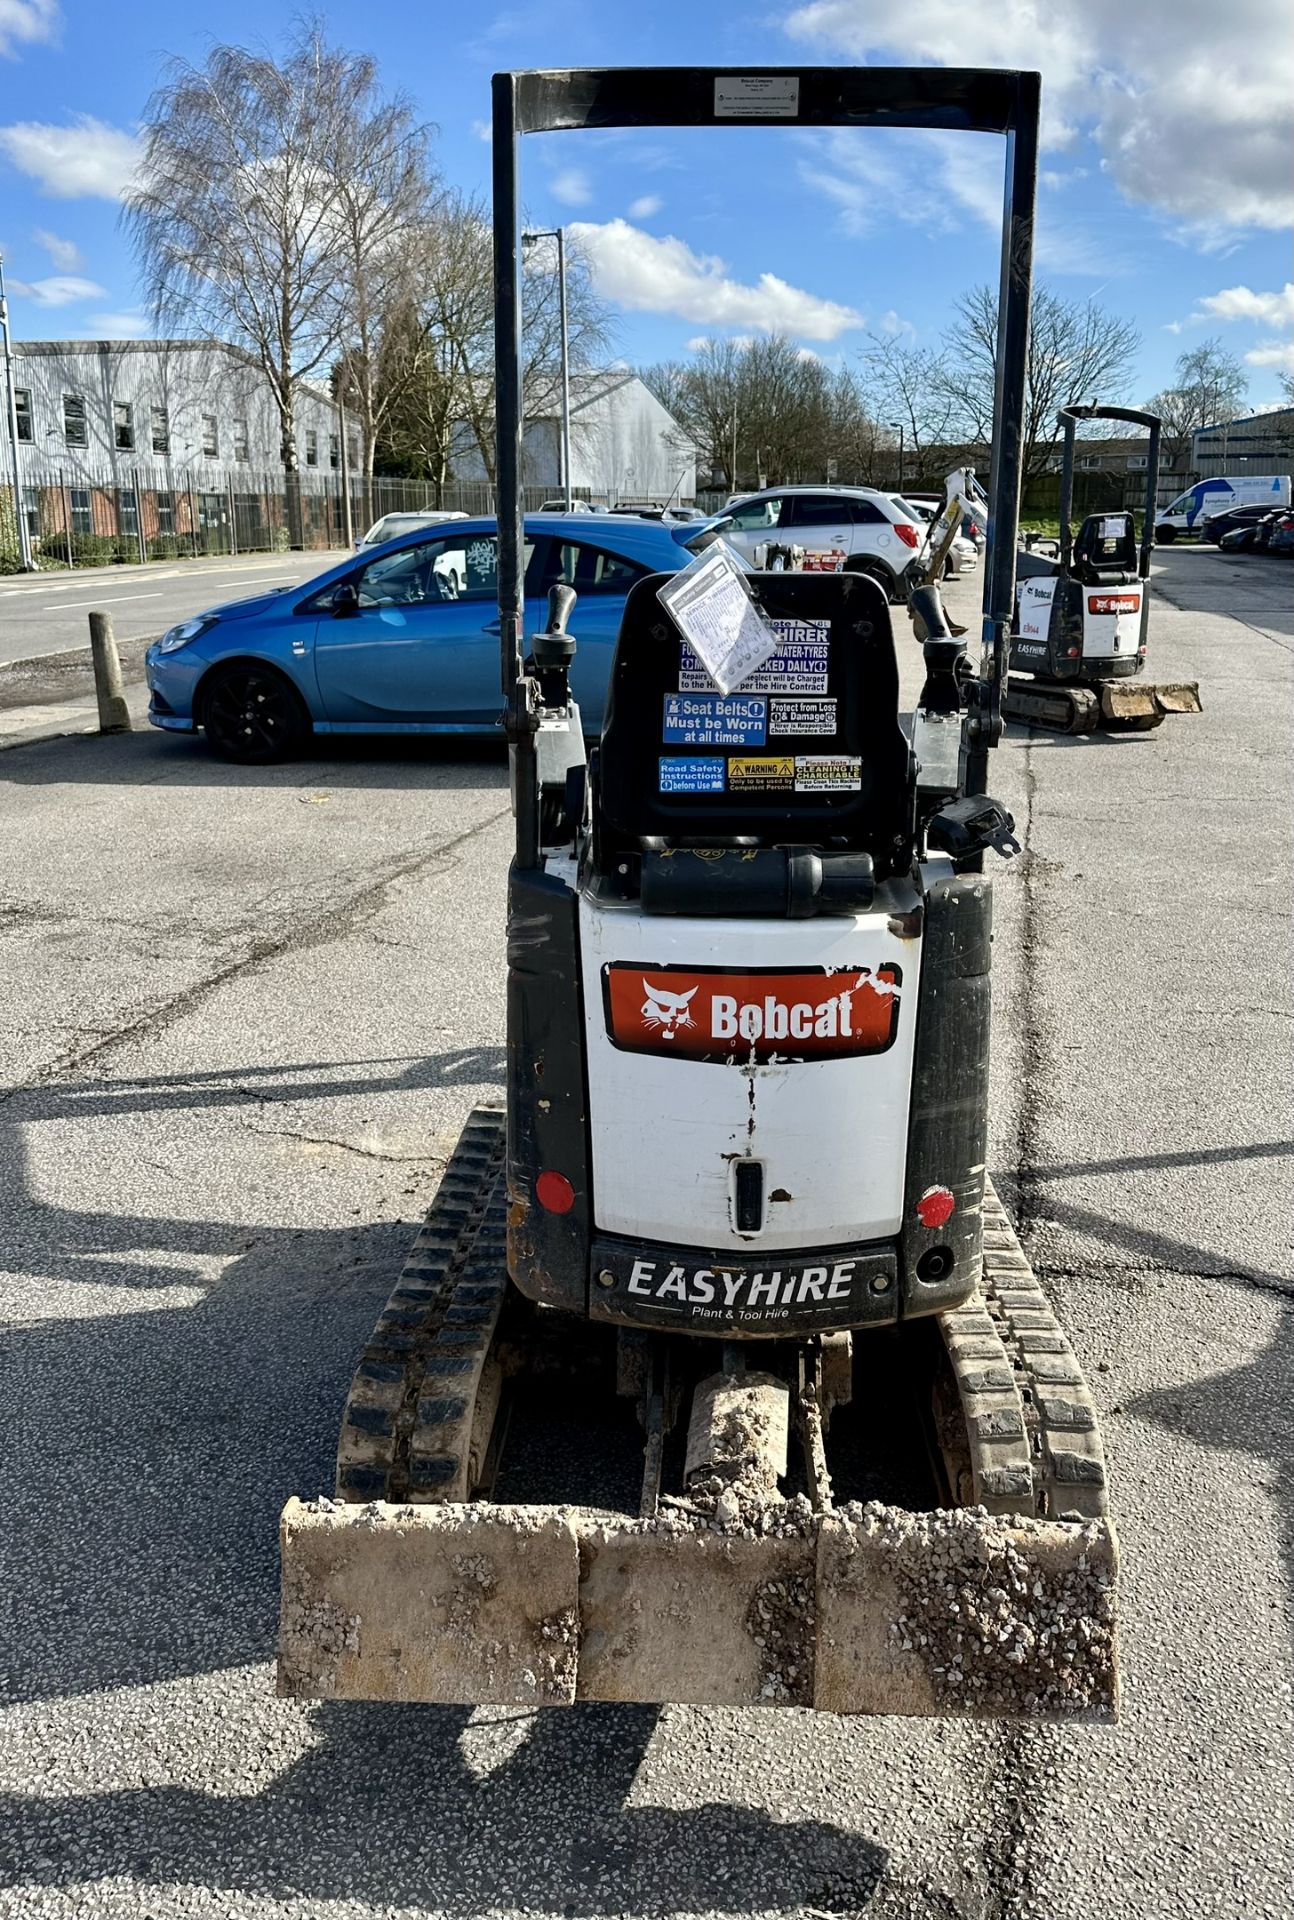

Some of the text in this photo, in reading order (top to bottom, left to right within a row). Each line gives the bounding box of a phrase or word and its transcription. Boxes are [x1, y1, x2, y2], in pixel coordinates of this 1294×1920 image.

[1110, 600, 1135, 611] Bobcat
[1017, 643, 1047, 655] EASYHIRE
[787, 660, 815, 672] DAILY
[682, 673, 707, 681] Repairs
[797, 675, 825, 683] Charged
[771, 682, 787, 690] Hire
[790, 683, 824, 691] Contract
[683, 700, 748, 716] Seat Belts
[771, 703, 836, 712] Protect from Loss
[782, 712, 825, 722] & Damage
[666, 716, 762, 730] Must be Worn
[685, 731, 745, 743] at all times
[690, 765, 723, 773] Safety
[745, 765, 778, 773] WARNING
[673, 781, 711, 789] before Use
[711, 995, 853, 1040] Bobcat
[627, 1260, 856, 1306] EASYHIRE
[692, 1306, 722, 1319] Plant
[725, 1310, 734, 1319] &
[765, 1306, 789, 1319] Hire
